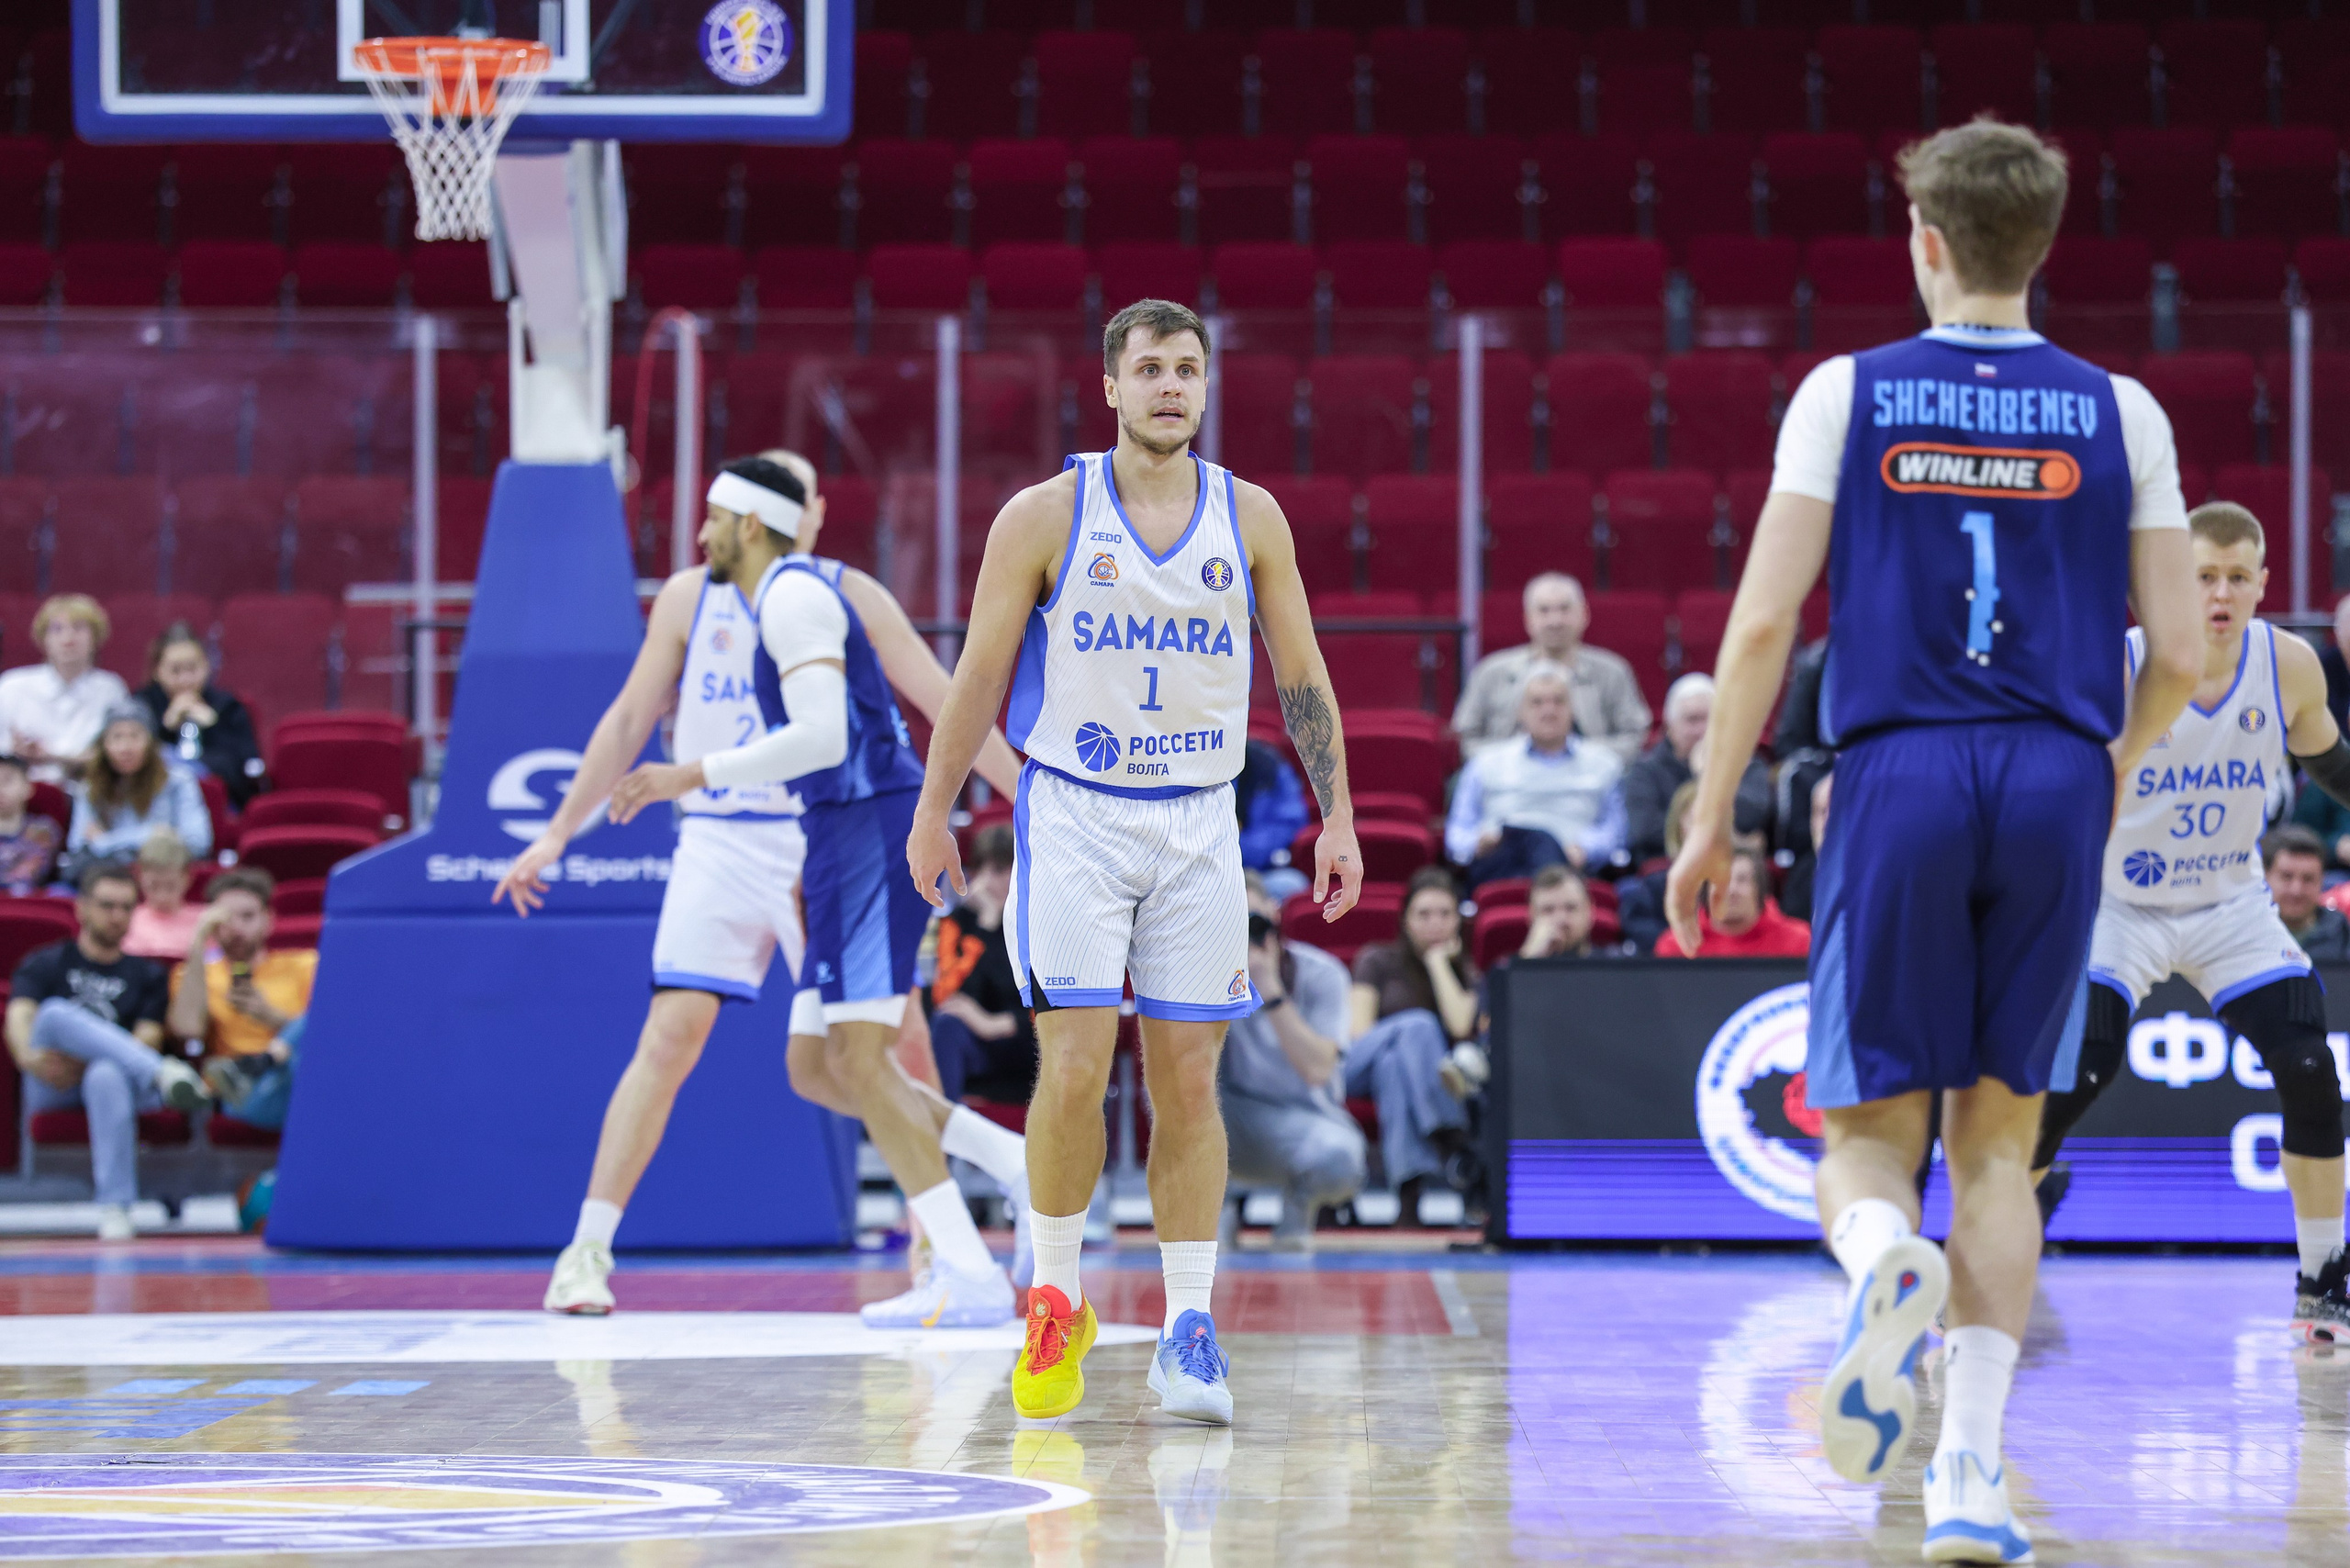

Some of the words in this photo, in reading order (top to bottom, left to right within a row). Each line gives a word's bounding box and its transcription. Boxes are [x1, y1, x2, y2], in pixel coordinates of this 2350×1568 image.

[1873, 378, 2098, 439] SHCHERBENEV
[1897, 453, 2038, 489] WINLINE
[1090, 532, 1122, 543] ZEDO
[1959, 510, 2001, 655] 1
[1073, 610, 1234, 657] SAMARA
[1138, 666, 1163, 711] 1
[1128, 728, 1225, 756] РОССЕТИ
[1126, 762, 1170, 777] ВОЛГА
[2135, 757, 2266, 799] SAMARA
[2170, 801, 2226, 841] 30
[1044, 976, 1076, 987] ZEDO
